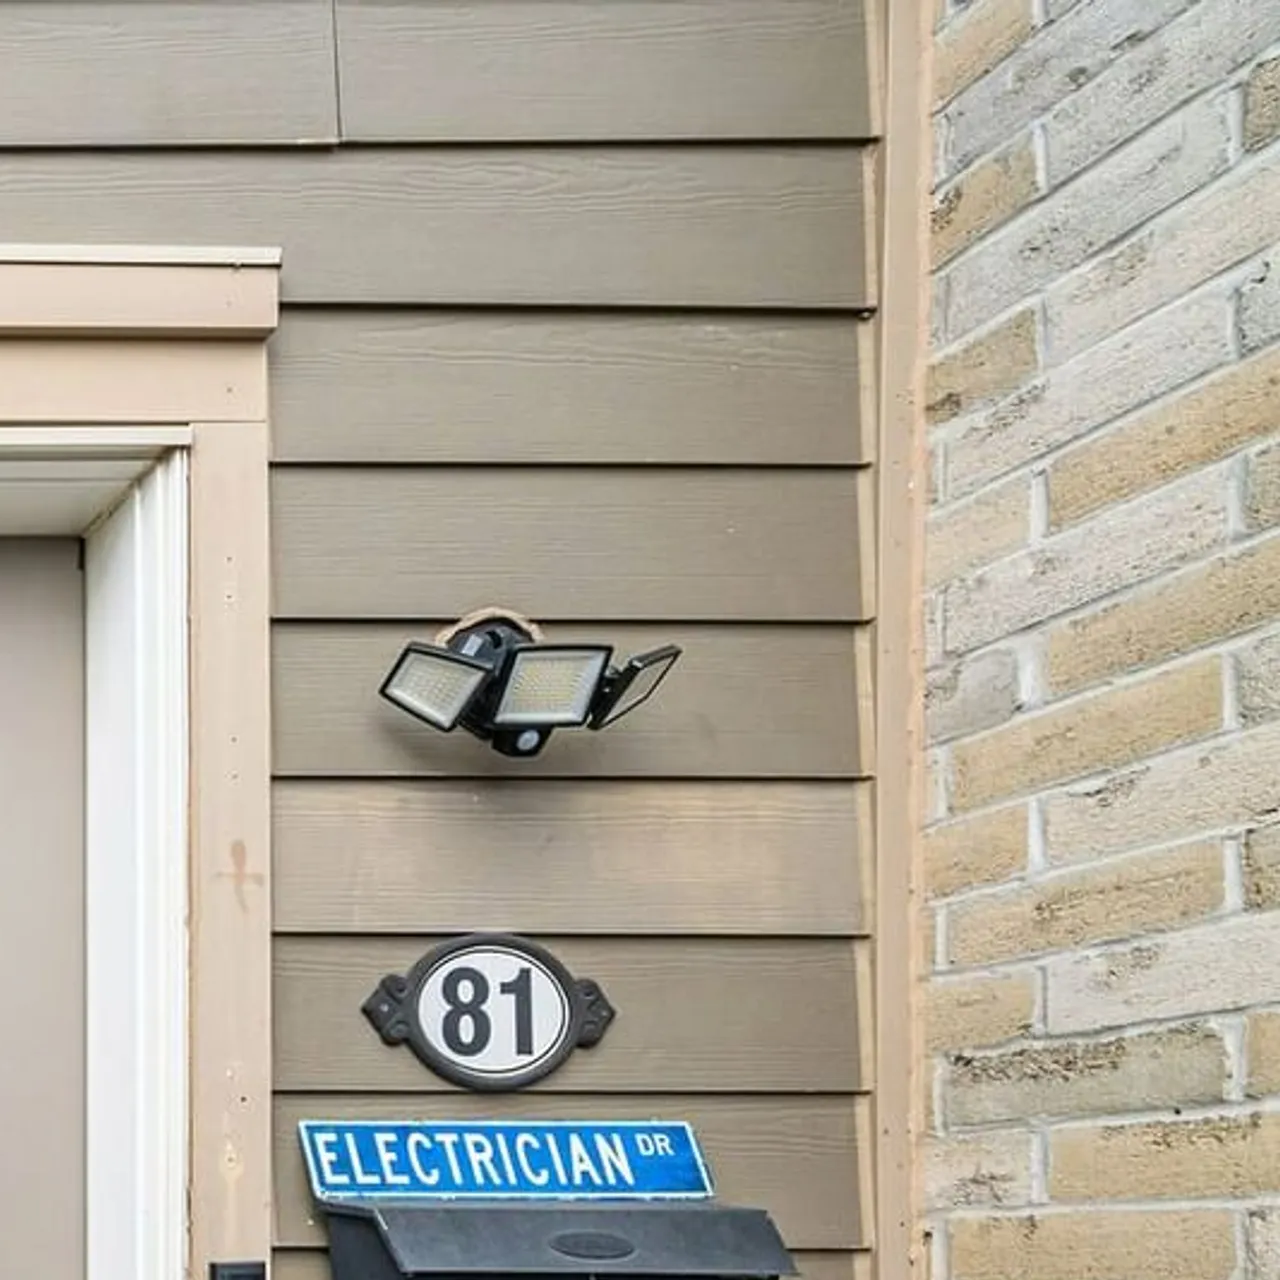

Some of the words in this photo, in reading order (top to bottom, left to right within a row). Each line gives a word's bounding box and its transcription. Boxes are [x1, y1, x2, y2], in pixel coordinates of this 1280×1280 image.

[443, 967, 534, 1056] 81
[314, 1132, 634, 1186] ELECTRICIAN
[638, 1133, 674, 1156] DR
